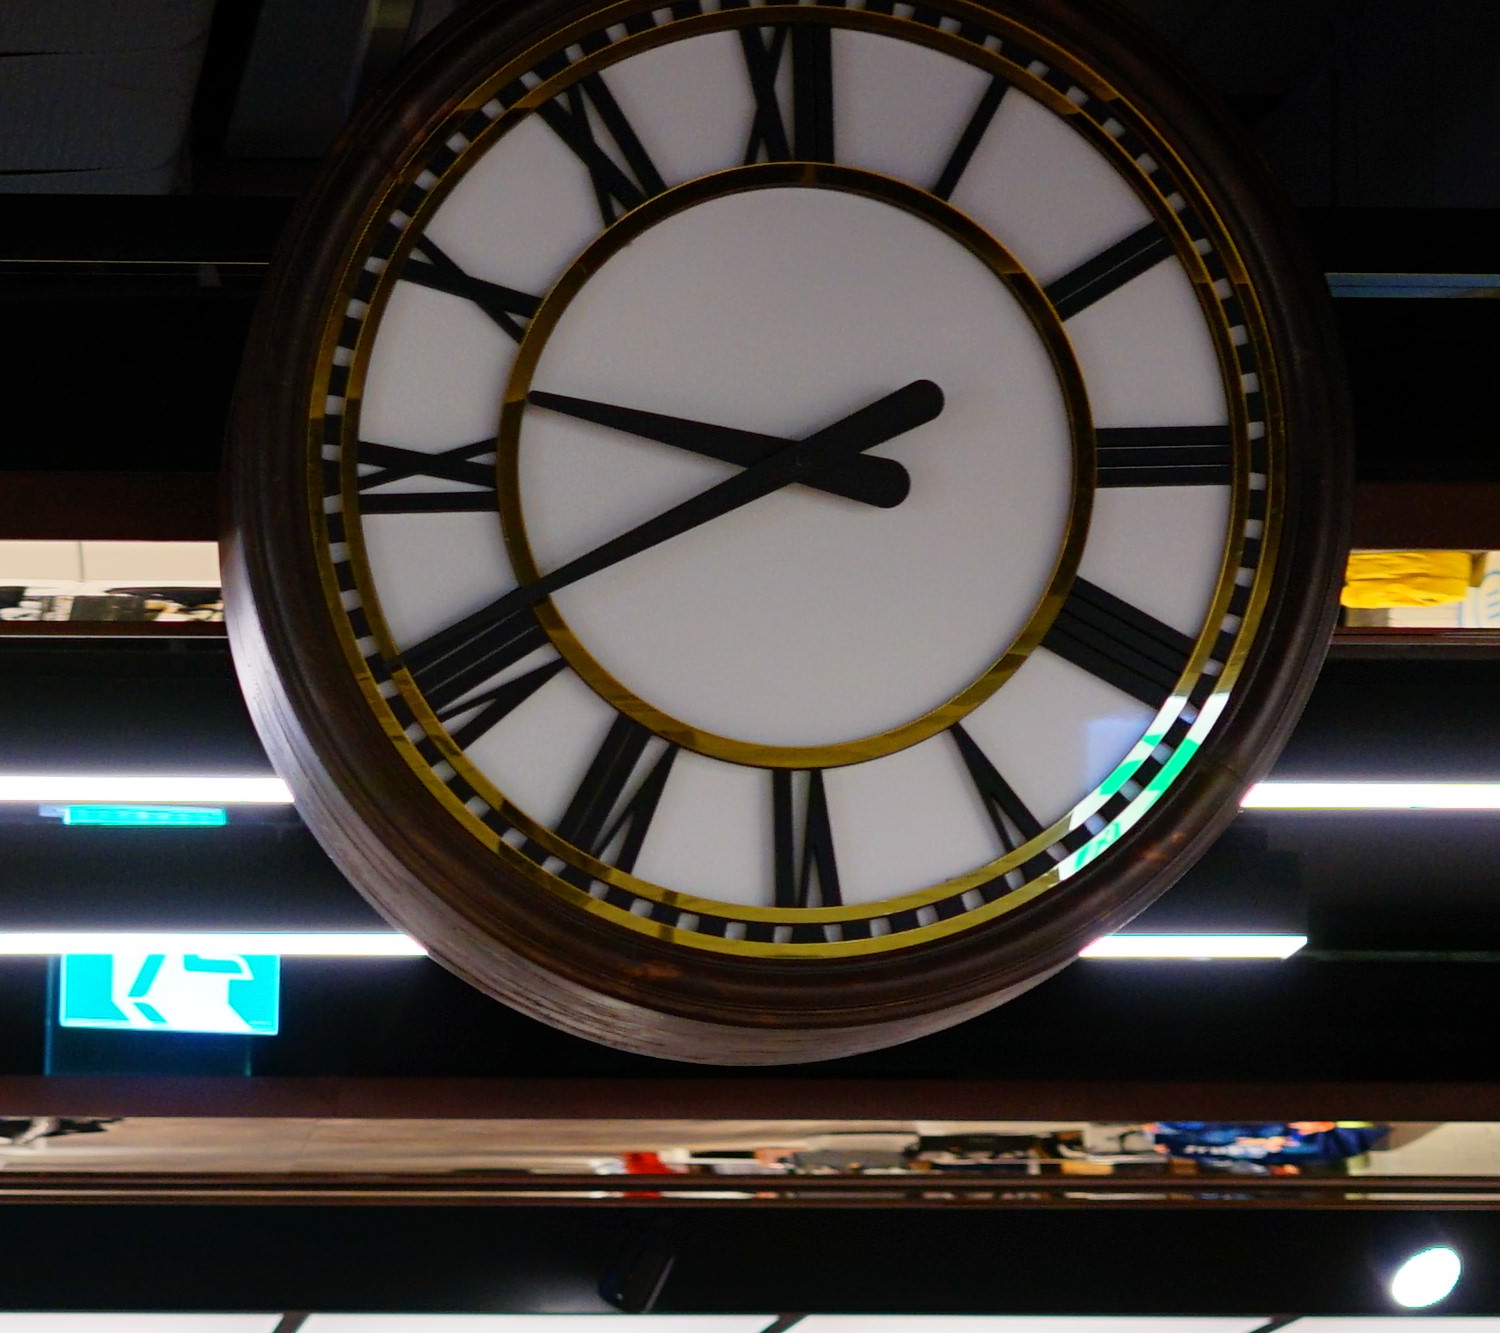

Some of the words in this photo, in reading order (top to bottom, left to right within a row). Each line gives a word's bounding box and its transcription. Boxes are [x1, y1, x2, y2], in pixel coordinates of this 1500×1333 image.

[536, 72, 668, 230] XI
[738, 26, 836, 165] XII
[932, 76, 1012, 201] I
[401, 236, 542, 344] X
[1044, 220, 1176, 322] II
[359, 438, 501, 514] IX
[1095, 425, 1230, 488] III
[556, 712, 681, 875] VII
[771, 768, 843, 908] VI
[950, 722, 1043, 852] V
